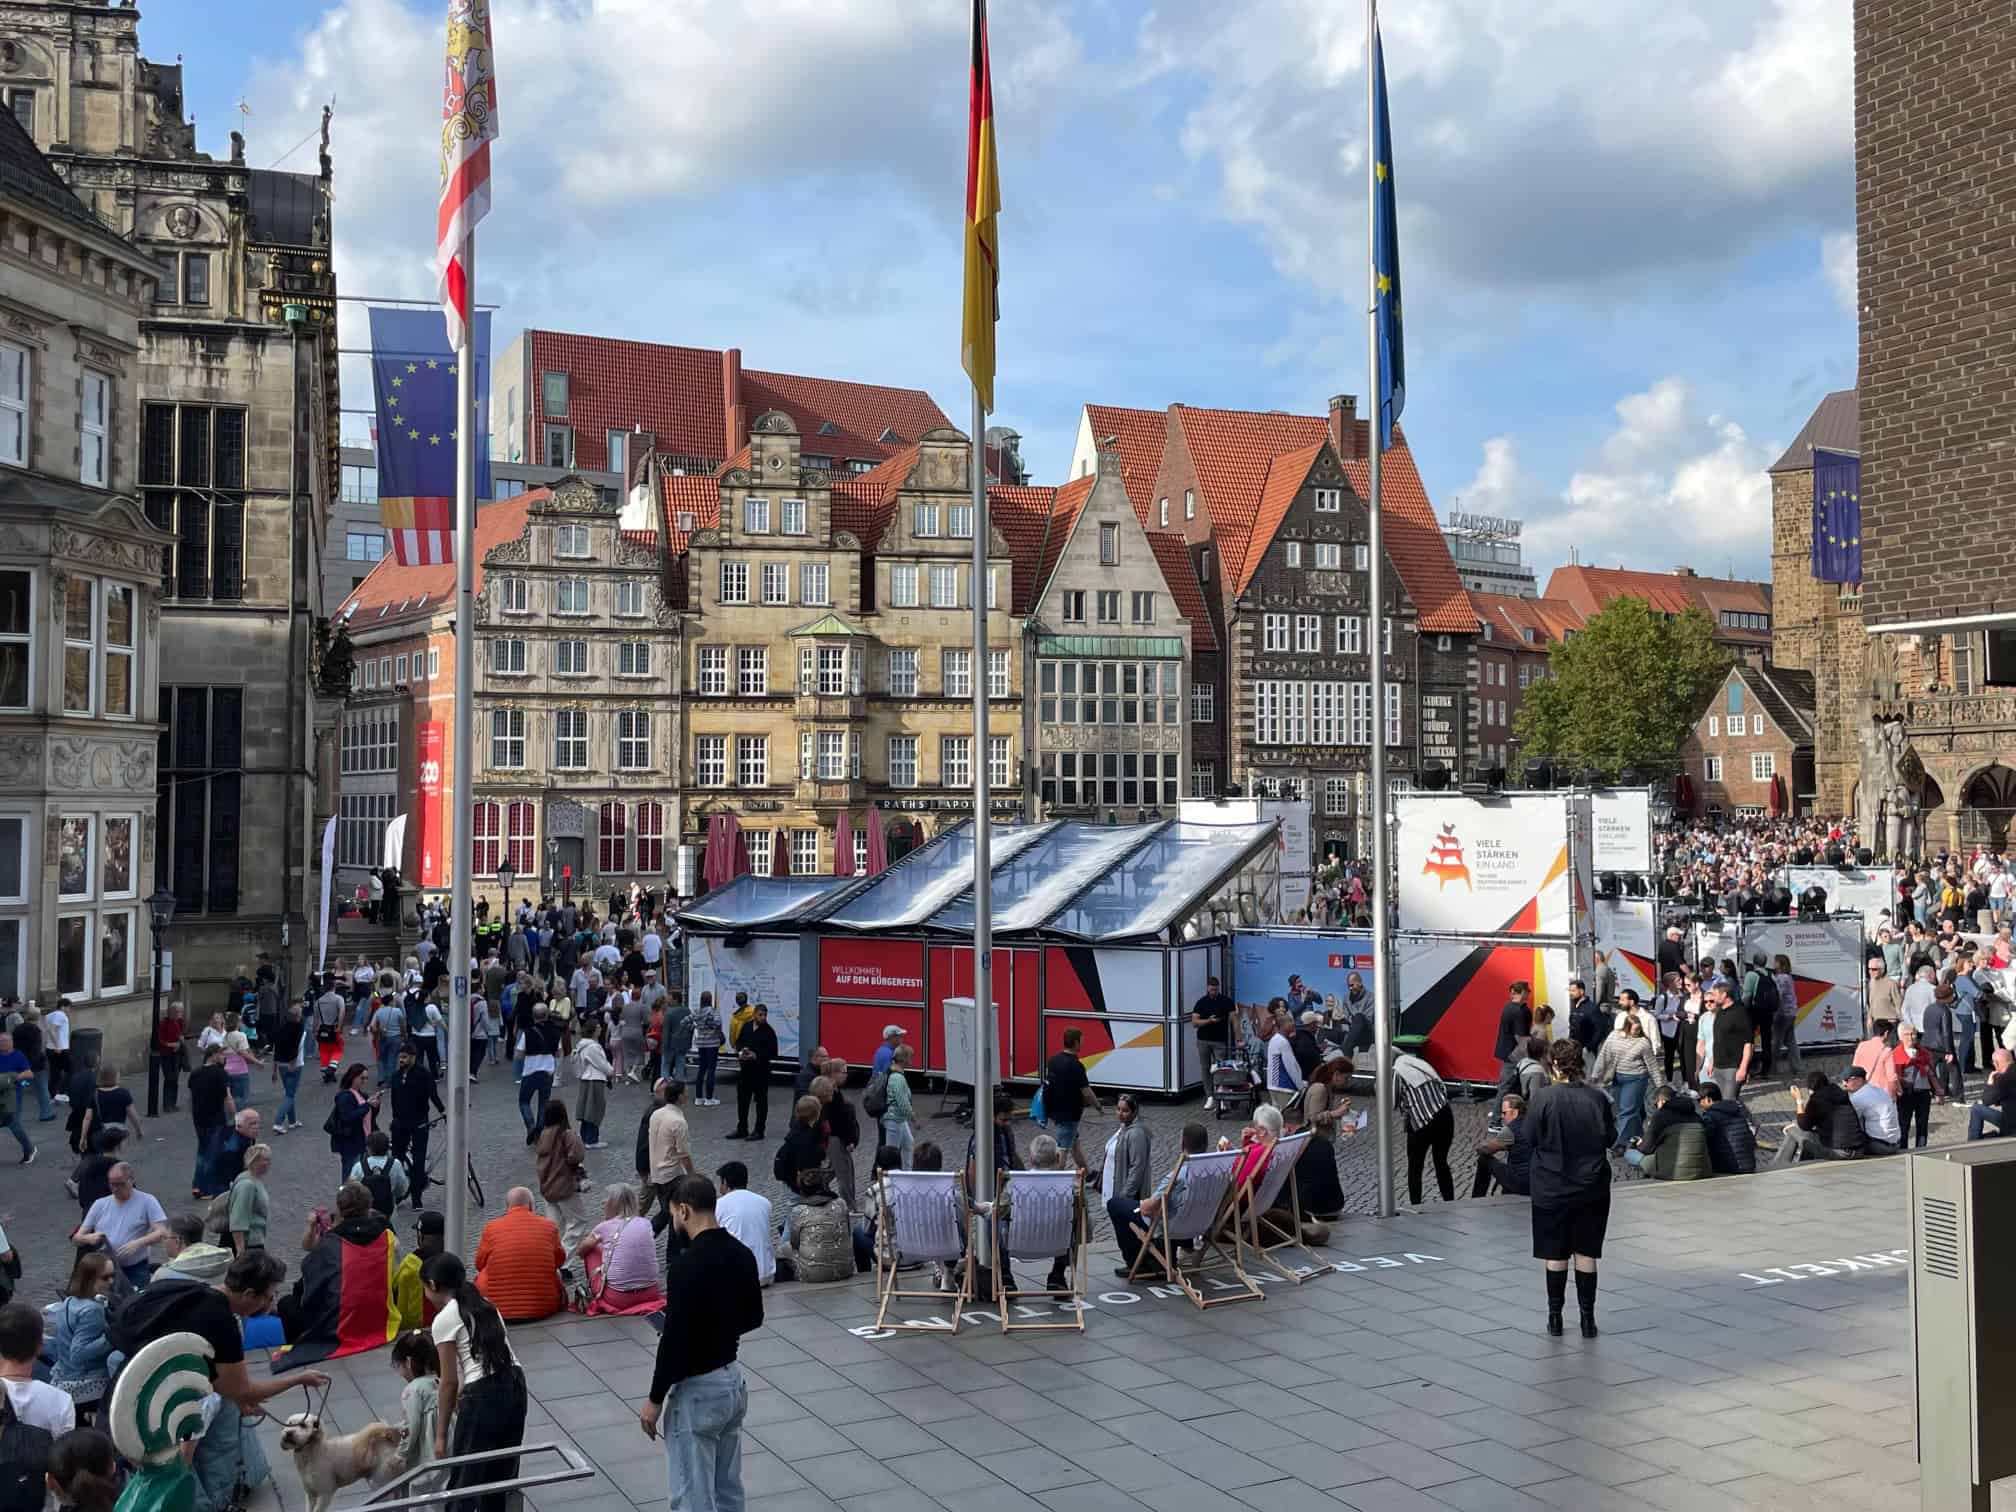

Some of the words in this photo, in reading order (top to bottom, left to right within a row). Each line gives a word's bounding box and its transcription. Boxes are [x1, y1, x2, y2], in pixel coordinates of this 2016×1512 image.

[1449, 511, 1523, 537] KARSTADT
[883, 800, 925, 809] RATHS
[1476, 839, 1502, 848] VIELE
[1476, 850, 1519, 859] STÄRKEN
[832, 965, 882, 976] WILLKOMMEN
[836, 975, 852, 985] AUF
[853, 976, 870, 985] DEM
